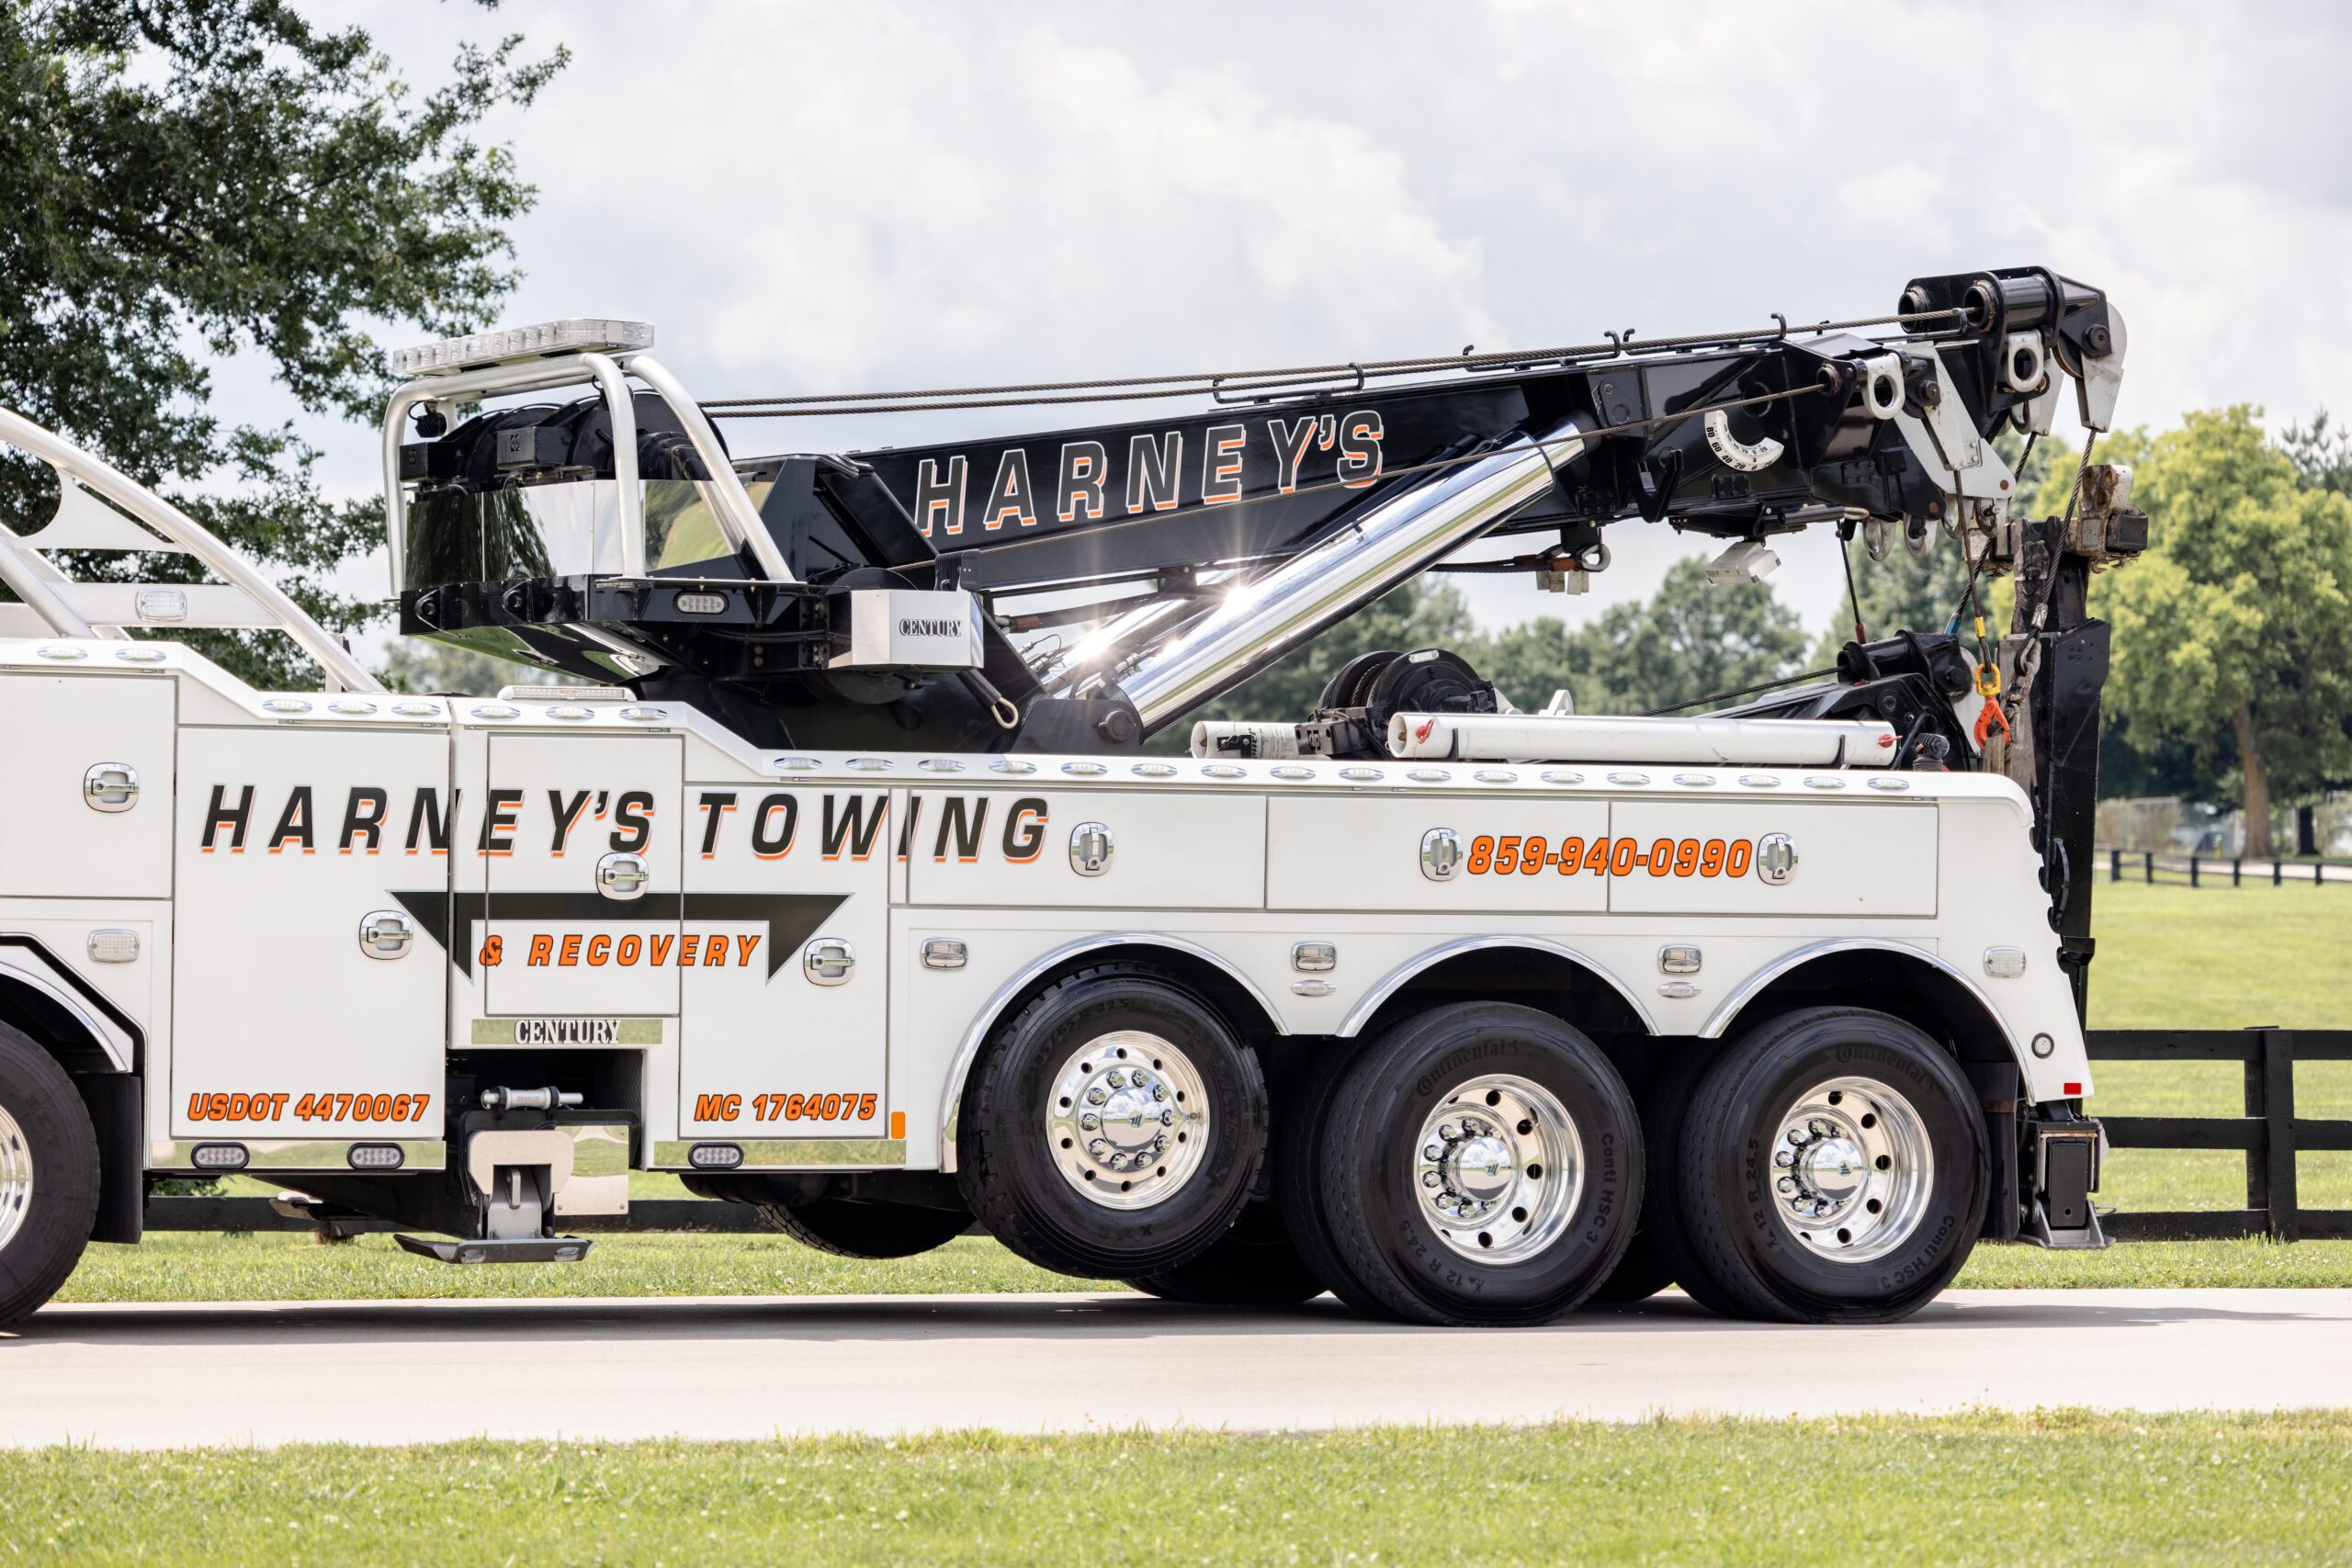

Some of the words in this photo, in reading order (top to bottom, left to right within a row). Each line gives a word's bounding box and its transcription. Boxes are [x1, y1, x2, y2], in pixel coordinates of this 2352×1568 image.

[1706, 426, 1715, 438] 80
[1712, 442, 1723, 453] 60
[914, 409, 1385, 536] HARNEY'S
[899, 617, 963, 638] CENTURY
[199, 784, 656, 858] HARNEY'S
[698, 792, 1049, 864] TOWING
[1467, 835, 1752, 878] 859-940-0990
[479, 934, 503, 967] &
[527, 934, 763, 967] RECOVERY
[514, 1018, 623, 1046] CENTURY
[188, 1093, 288, 1122] USDOT
[293, 1093, 431, 1122] 4470067
[694, 1093, 741, 1122] MC
[752, 1093, 878, 1122] 1764075
[1600, 1132, 1617, 1184] Conti
[1592, 1189, 1616, 1229] HSC
[1585, 1229, 1600, 1245] 3
[1924, 1214, 1956, 1259] Conti
[1429, 1257, 1443, 1275] R
[1446, 1269, 1464, 1287] 12
[1893, 1256, 1927, 1284] HSC
[1880, 1276, 1892, 1290] 3
